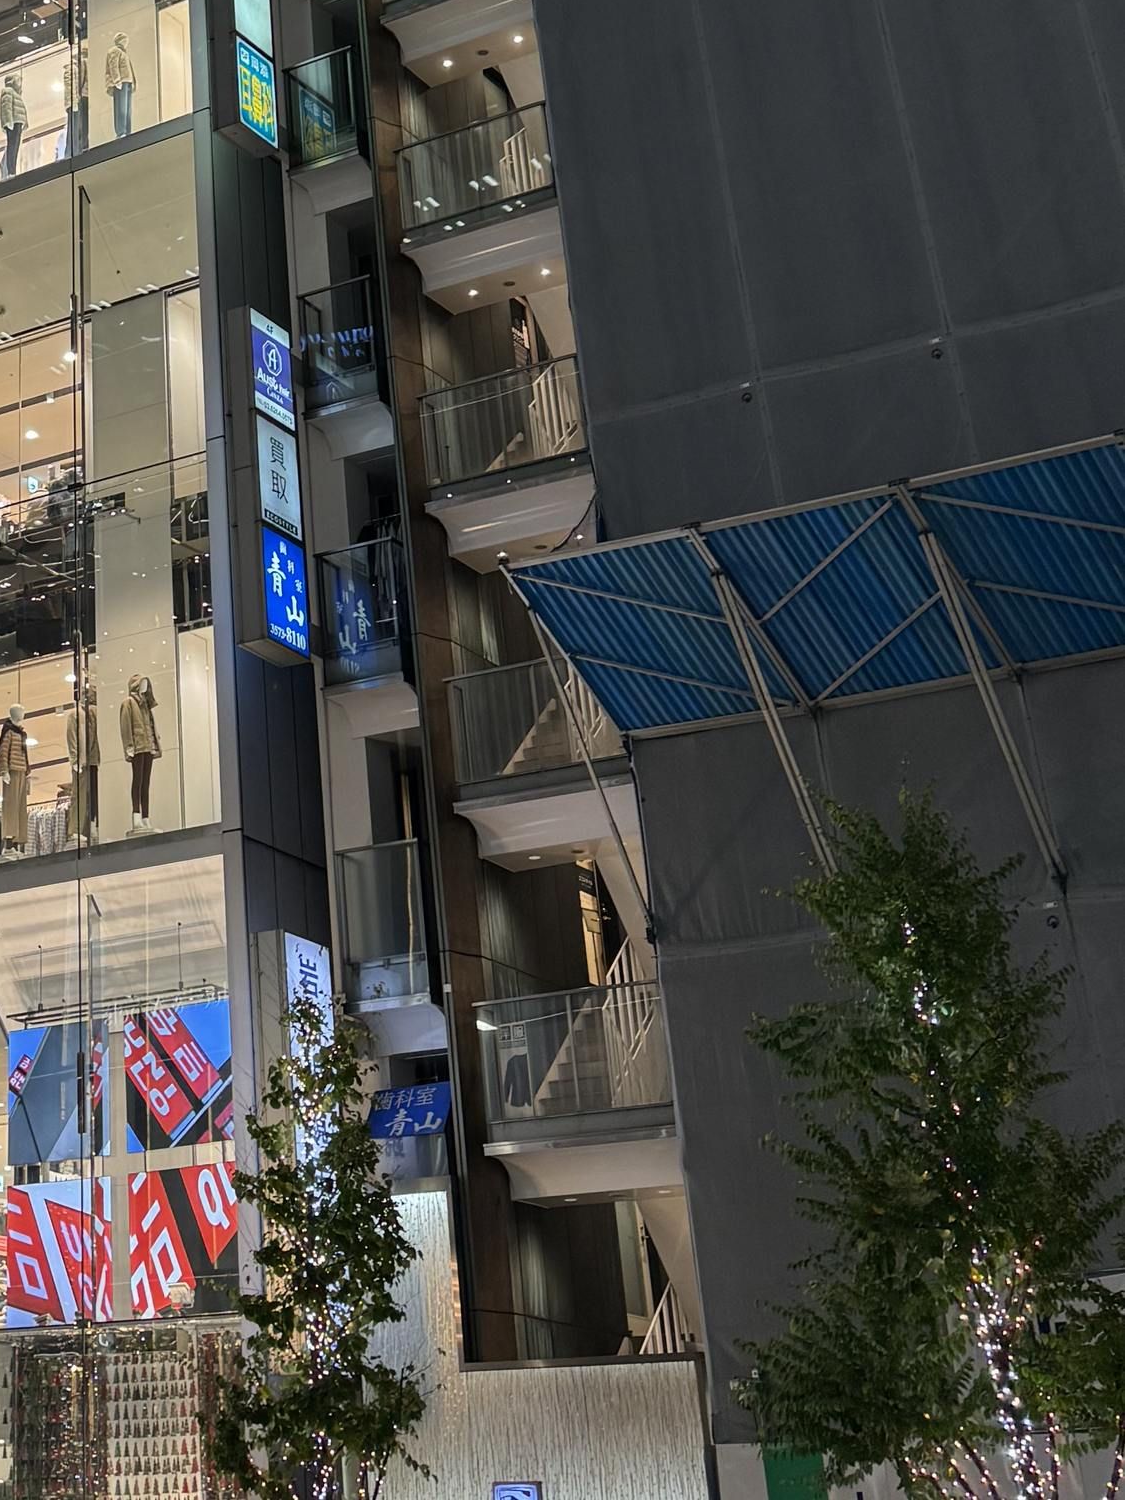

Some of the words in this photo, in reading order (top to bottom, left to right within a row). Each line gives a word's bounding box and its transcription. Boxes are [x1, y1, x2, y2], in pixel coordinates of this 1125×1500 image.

[269, 436, 289, 504] 買取
[269, 622, 307, 651] 3573-8110
[374, 1086, 437, 1111] 歯科室
[385, 1107, 443, 1137] 青山
